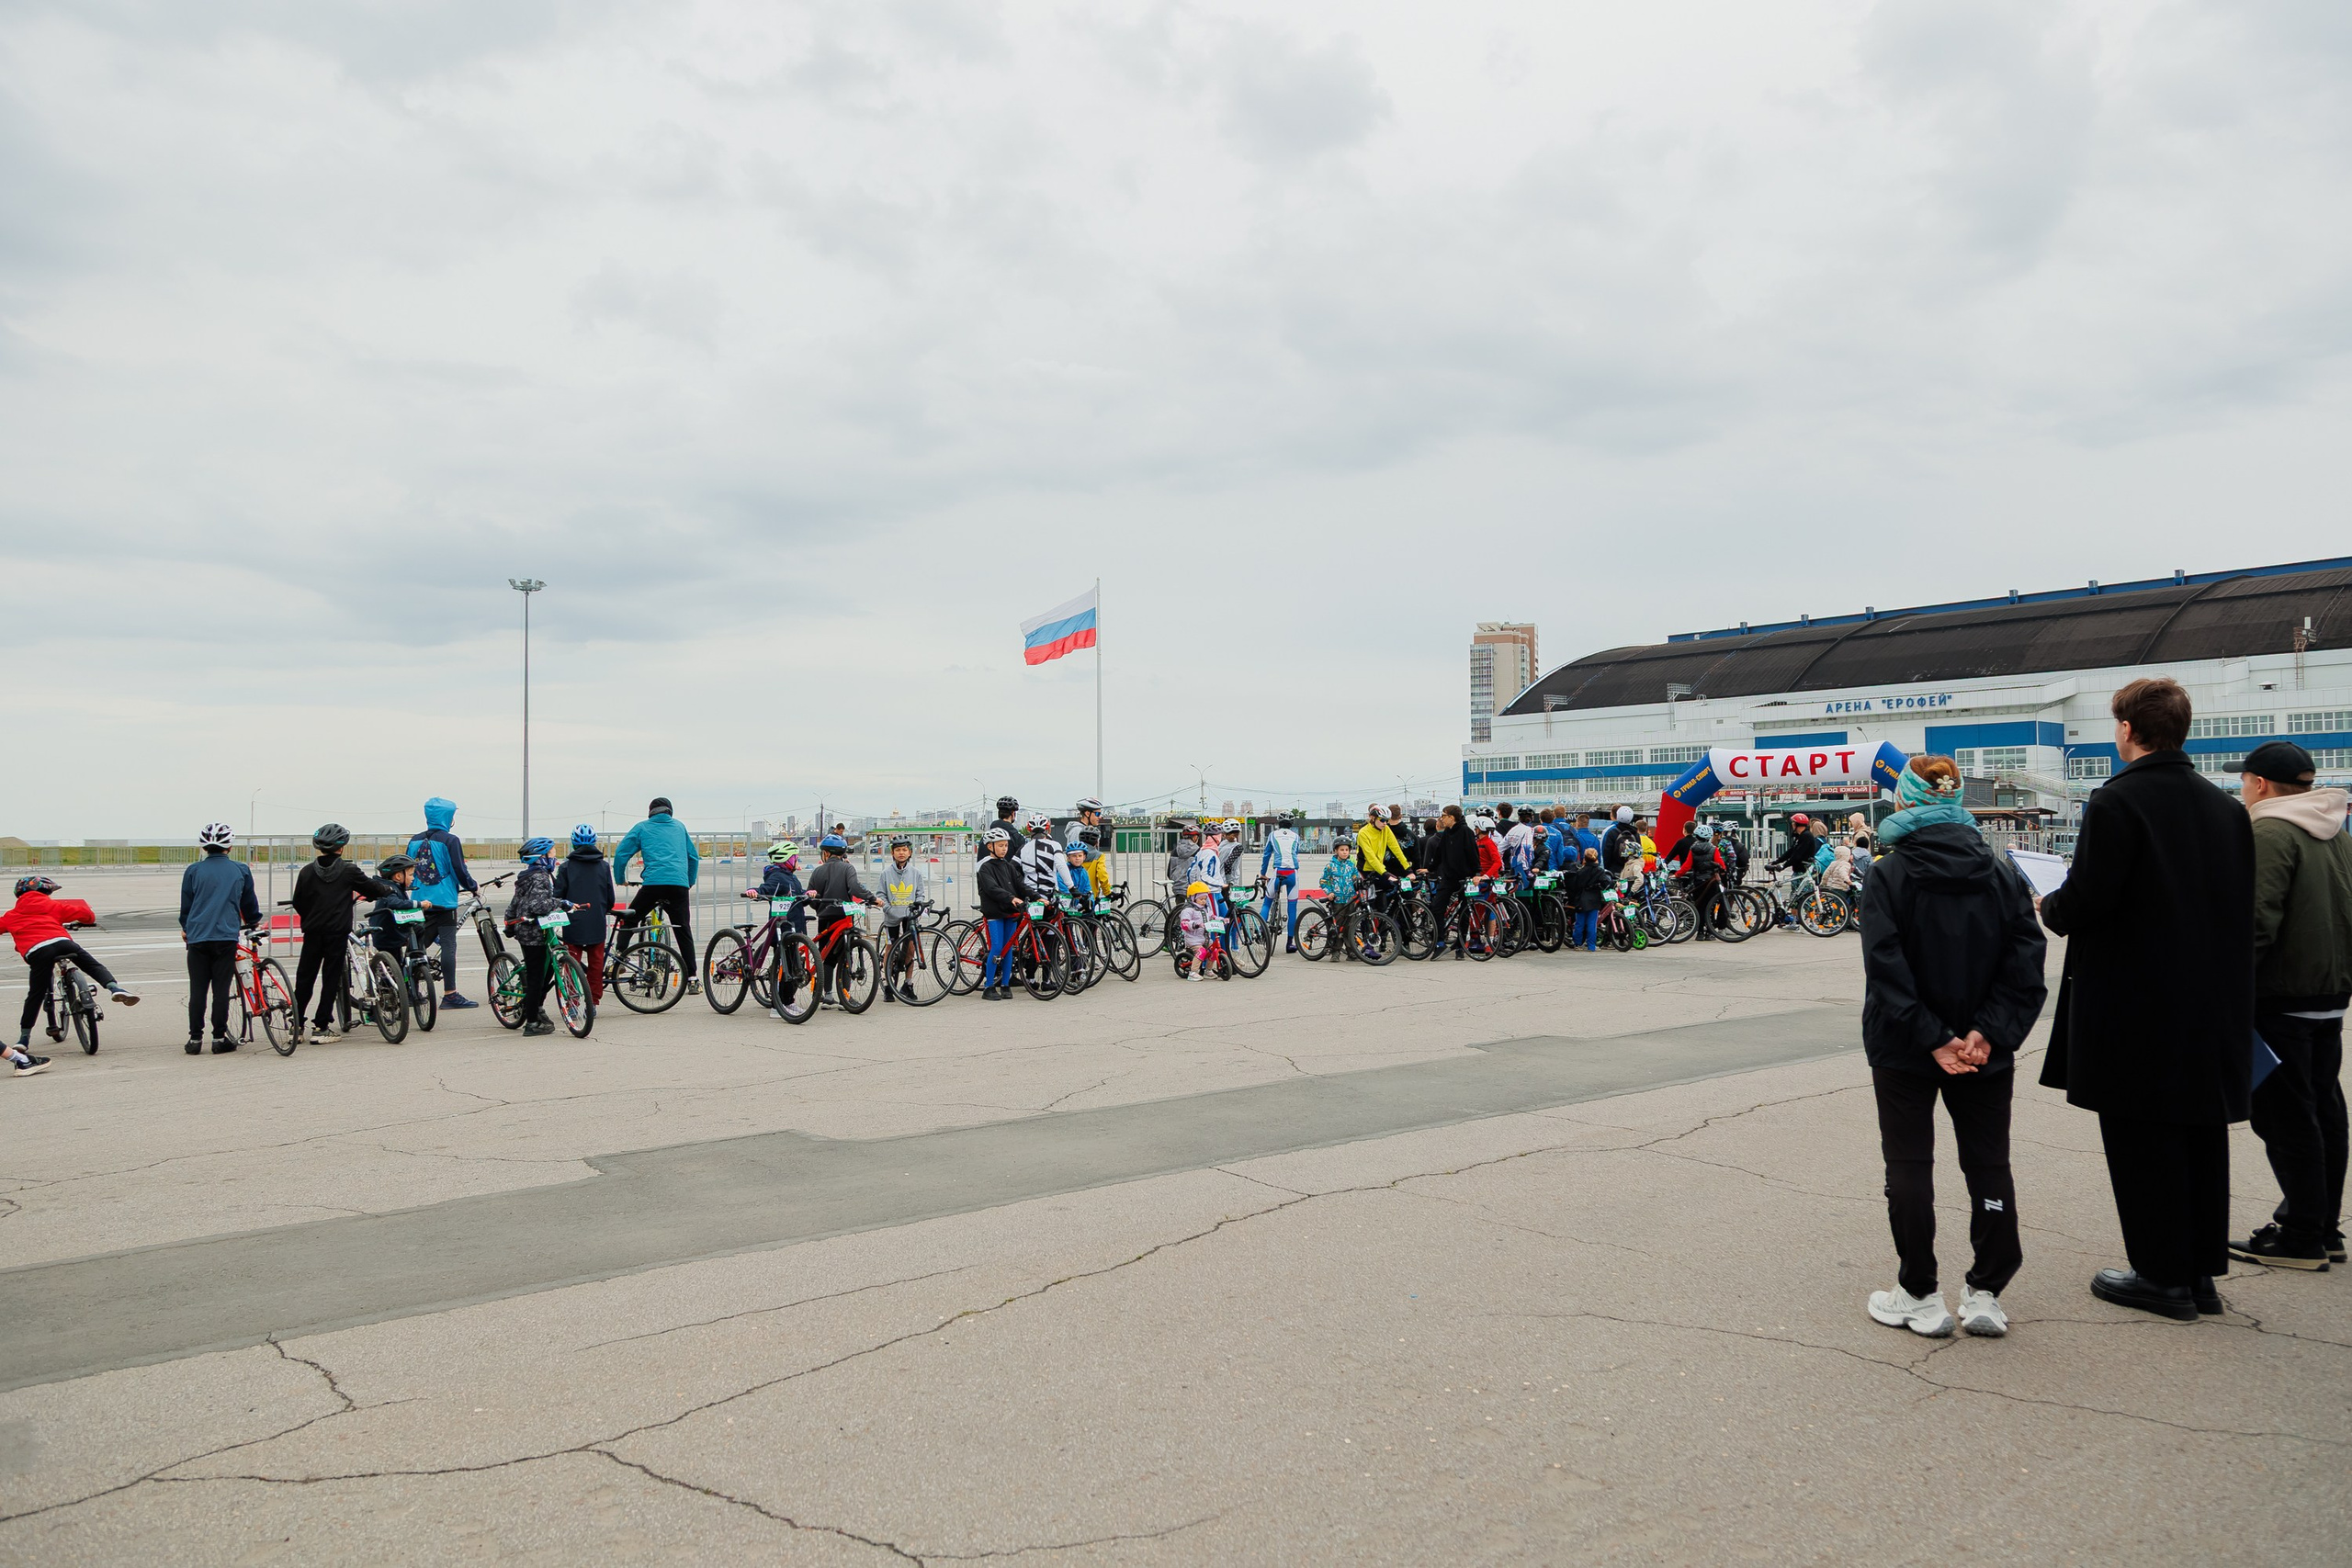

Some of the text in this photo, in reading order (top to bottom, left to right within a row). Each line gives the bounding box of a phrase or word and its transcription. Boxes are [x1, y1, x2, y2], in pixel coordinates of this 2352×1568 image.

[1826, 694, 1952, 714] АРЕНА "ЕРОФЕЙ"
[1728, 751, 1856, 778] СТАРТ
